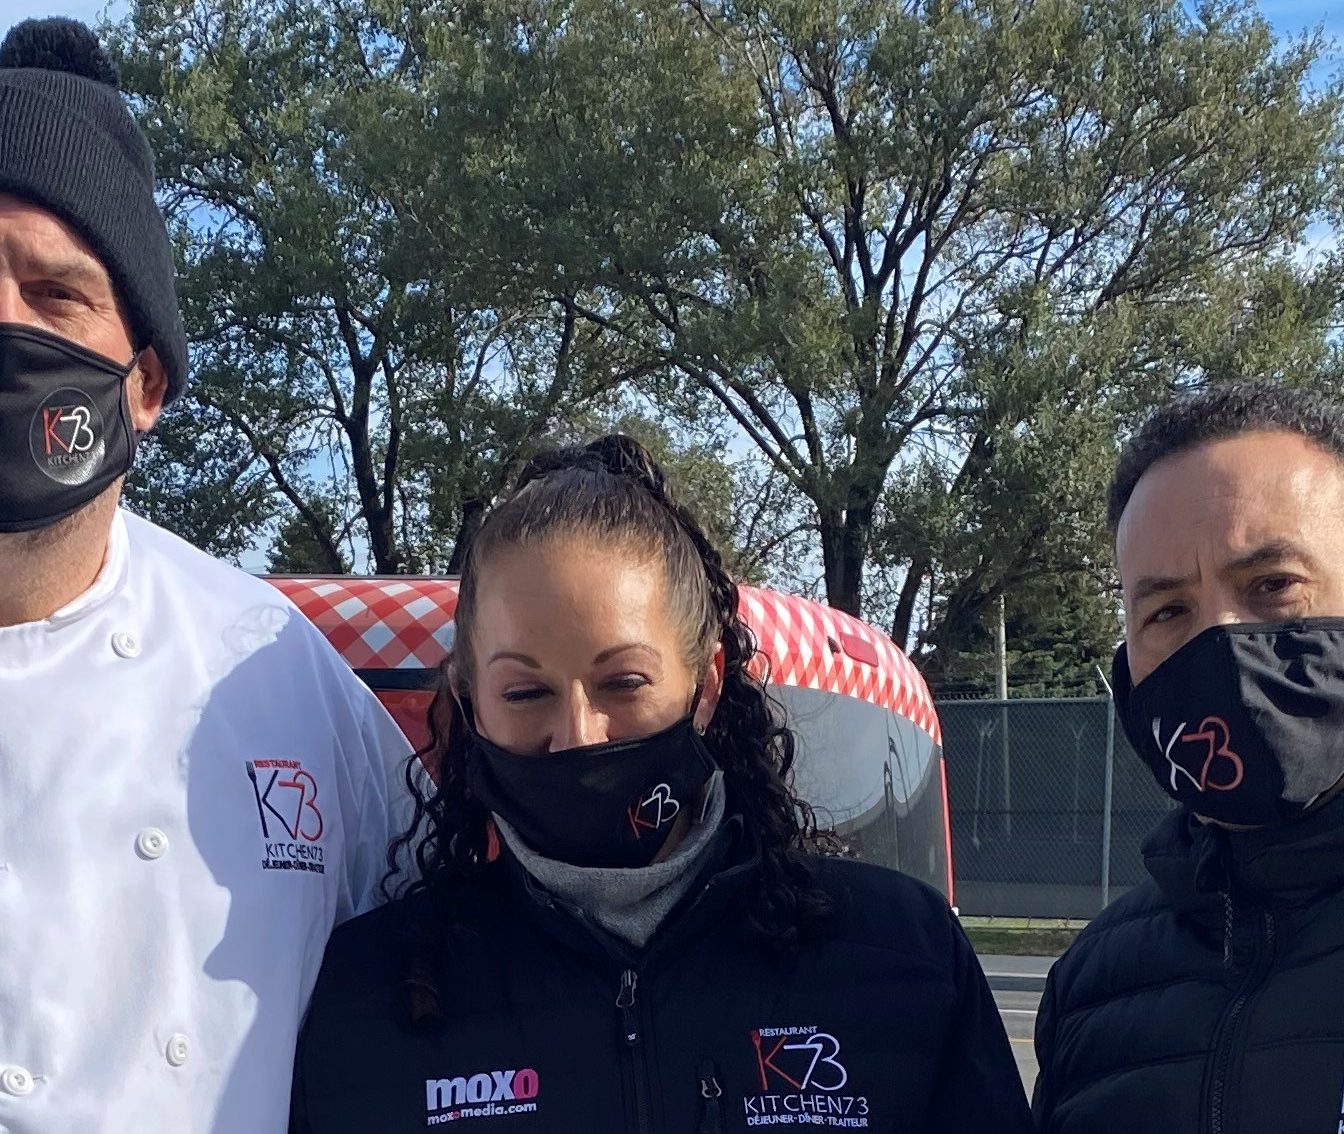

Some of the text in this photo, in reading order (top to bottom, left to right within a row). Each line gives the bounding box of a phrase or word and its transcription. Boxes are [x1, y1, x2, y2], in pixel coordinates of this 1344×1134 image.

[43, 405, 95, 455] K73
[1151, 715, 1244, 792] K73
[246, 761, 324, 842] K73
[627, 783, 680, 840] K73
[264, 843, 324, 861] KITCHEN73
[759, 1026, 818, 1037] RESTAURANT
[752, 1030, 848, 1091] K73
[426, 1068, 540, 1111] moxo
[744, 1094, 870, 1115] KITCHEN73
[427, 1102, 537, 1126] moxomedia.com
